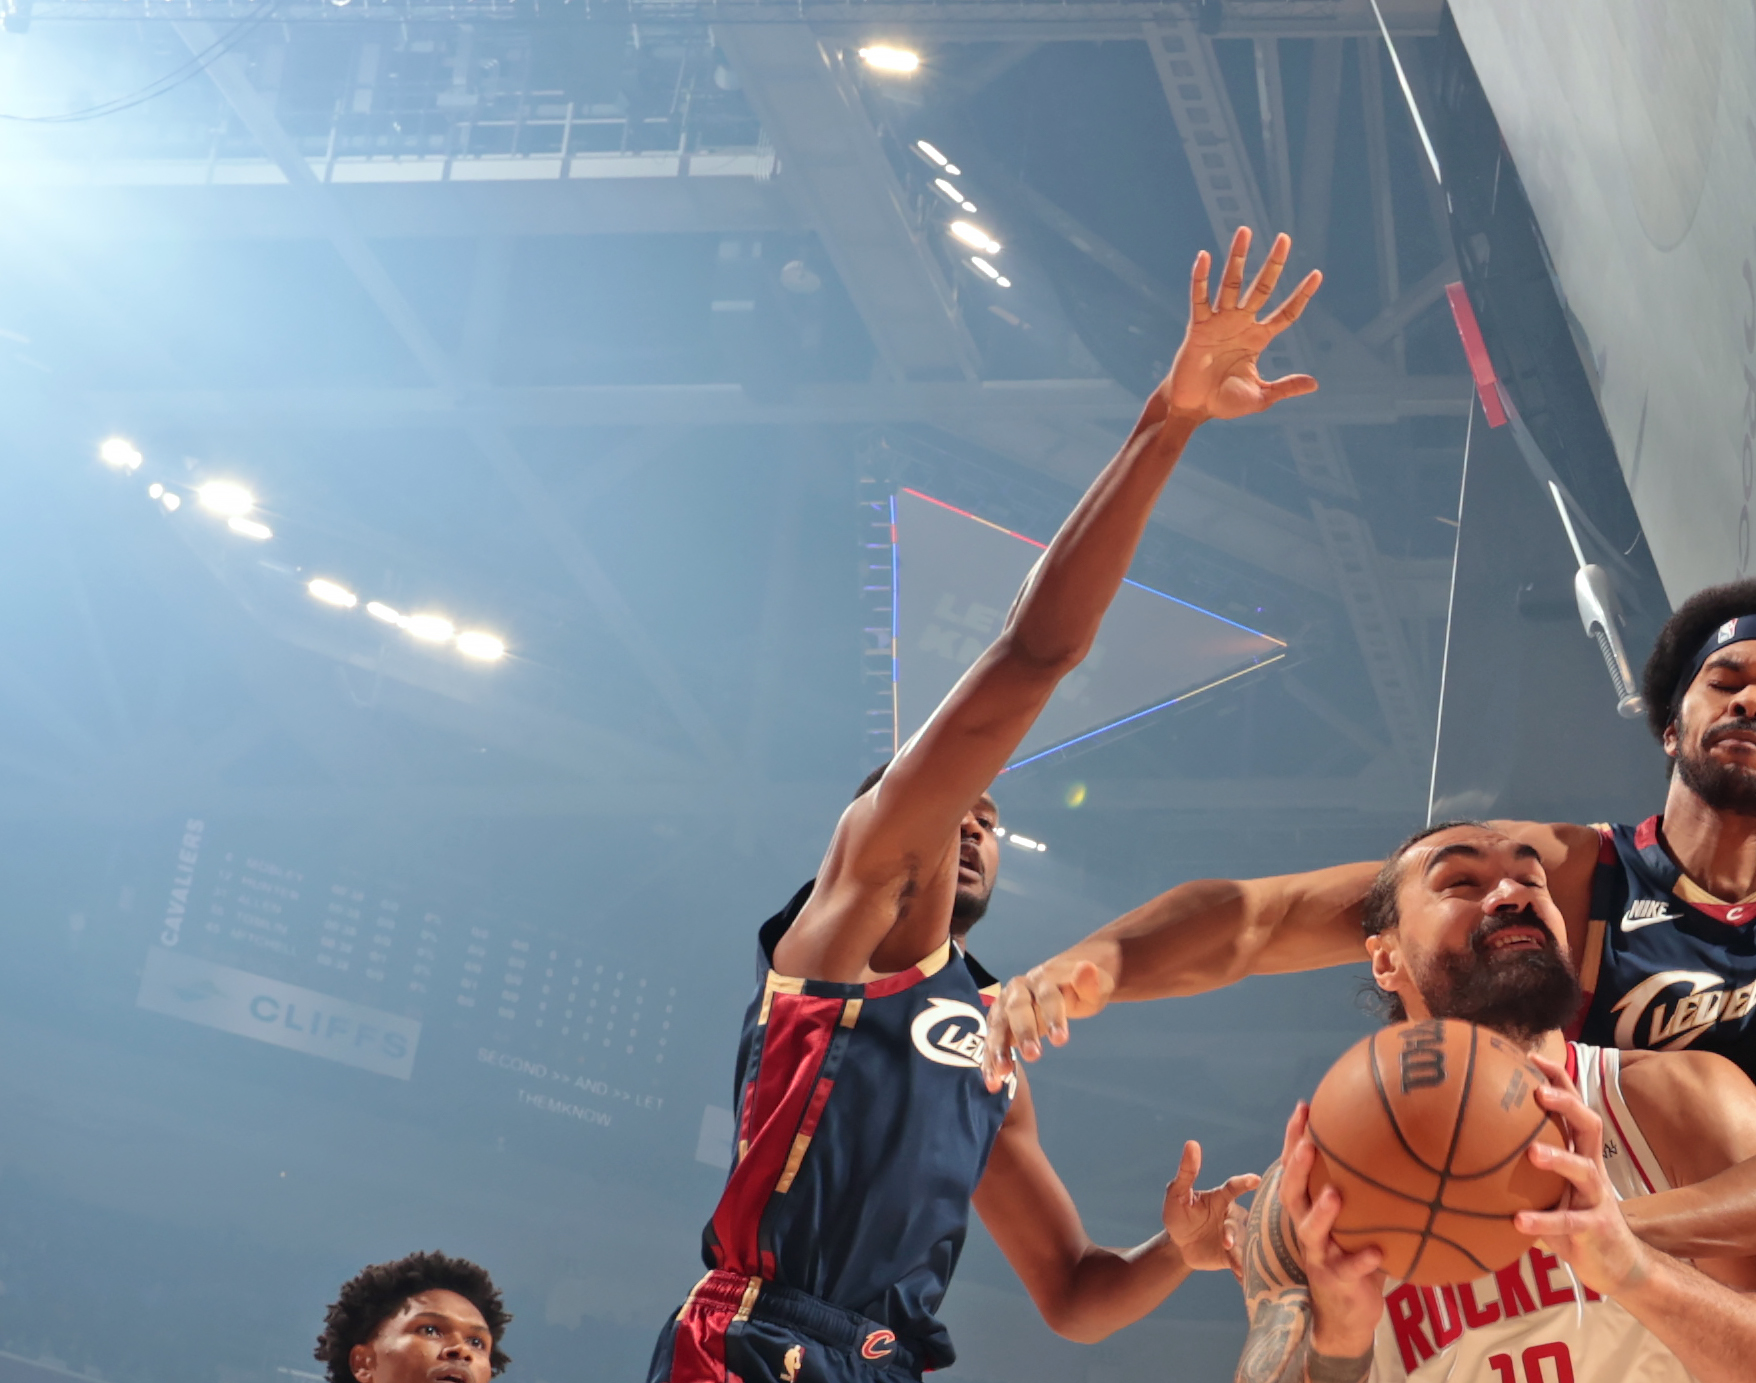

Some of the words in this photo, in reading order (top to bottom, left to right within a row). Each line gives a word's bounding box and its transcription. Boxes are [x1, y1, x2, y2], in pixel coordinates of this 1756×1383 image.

[161, 818, 205, 946] CAVALIERS
[1629, 899, 1669, 919] NIKE
[249, 995, 408, 1060] CLIFFS
[477, 1047, 546, 1079] SECOND
[574, 1075, 608, 1096] AND
[1385, 1249, 1604, 1376] ROCKE
